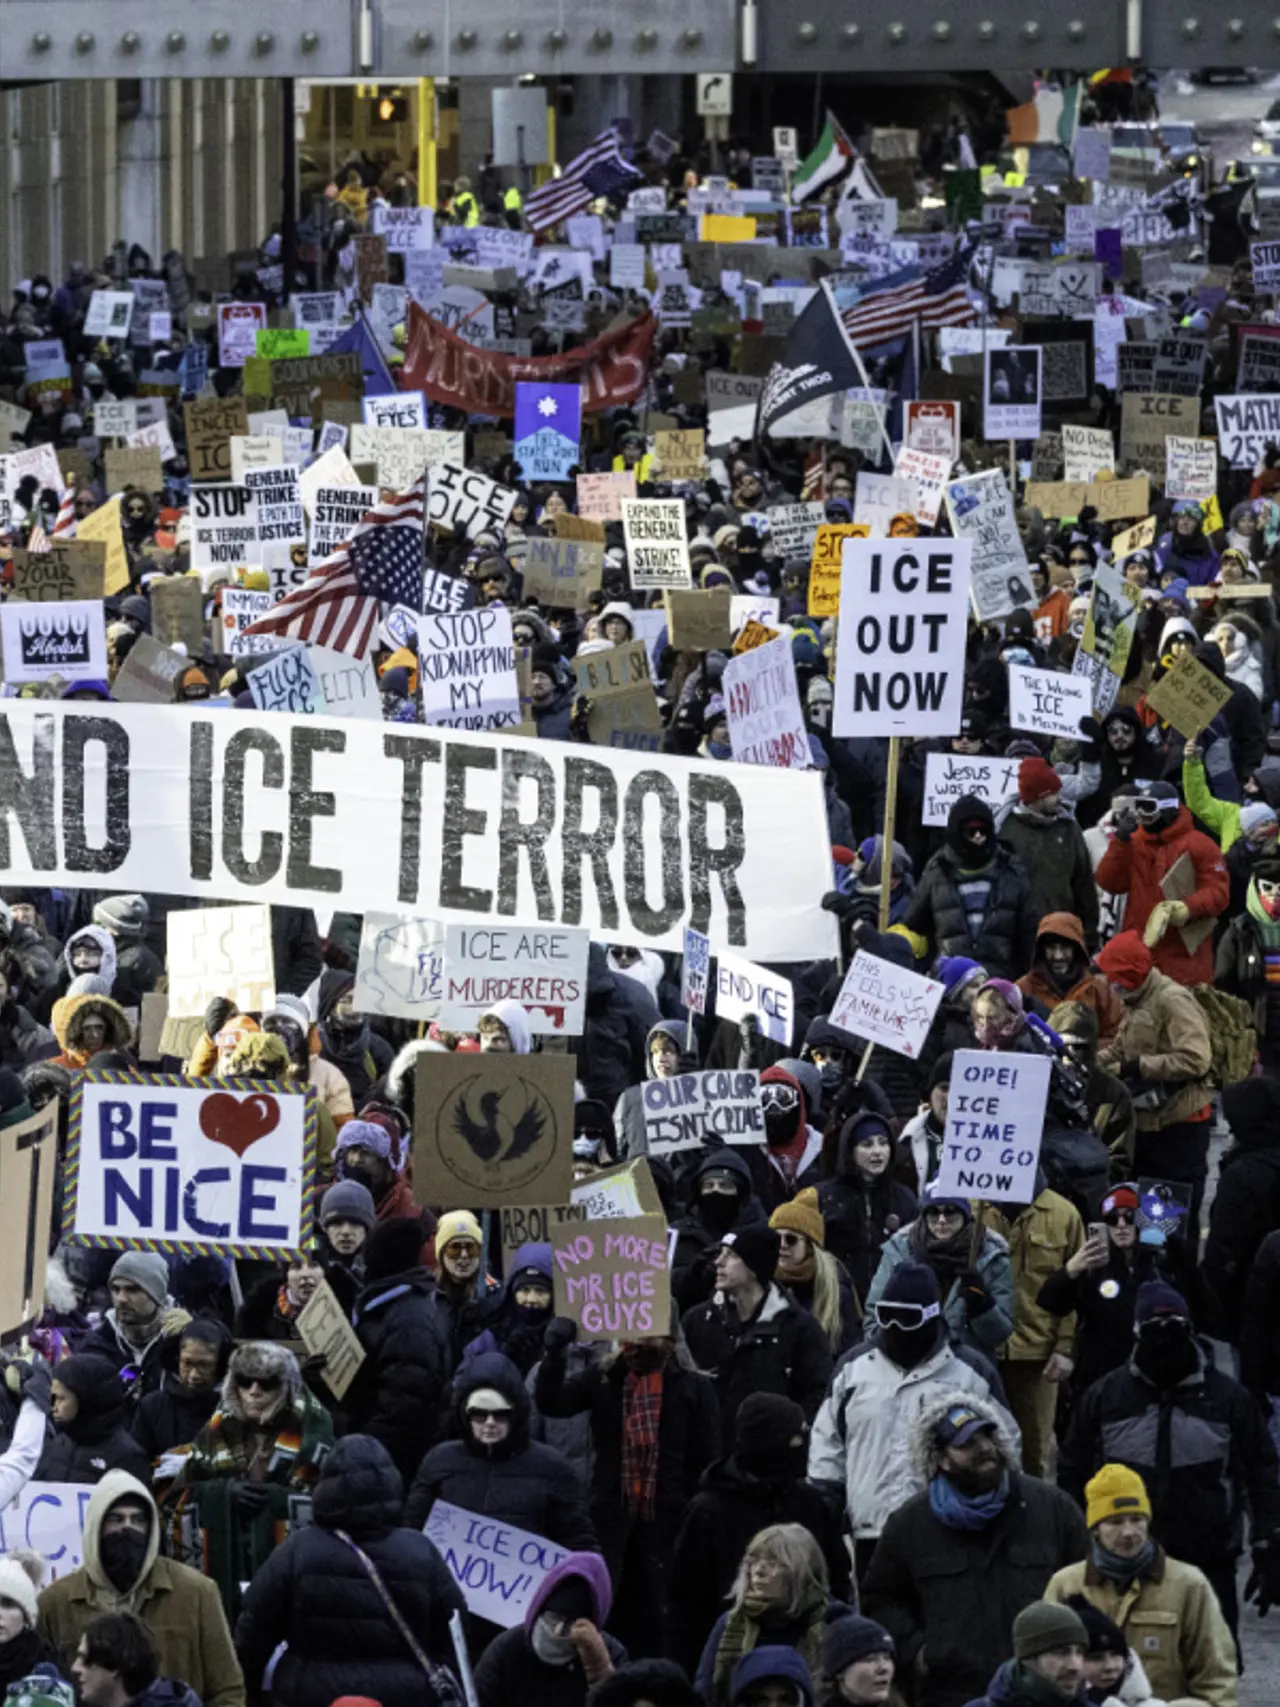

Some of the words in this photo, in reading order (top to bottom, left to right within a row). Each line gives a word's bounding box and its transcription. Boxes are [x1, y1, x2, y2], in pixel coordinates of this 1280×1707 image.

[386, 229, 417, 247] ICE
[1140, 396, 1184, 416] ICE
[244, 469, 298, 488] GENERAL
[533, 458, 563, 473] RUN
[194, 487, 252, 518] STOP
[315, 488, 375, 507] GENERAL
[438, 463, 514, 513] ICE
[627, 504, 660, 519] EXPAND
[660, 503, 681, 519] THE
[197, 526, 220, 543] ICE
[221, 525, 256, 543] TERROR
[630, 521, 683, 541] GENERAL
[210, 543, 248, 563] NOW!
[635, 548, 681, 567] STRIKE!
[18, 564, 75, 583] YOUR
[870, 554, 953, 594] ICE
[429, 611, 497, 650] STOP
[856, 614, 949, 654] OUT
[422, 650, 517, 682] KIDNAPPING
[251, 651, 312, 711] FUCK
[853, 672, 949, 713] NOW
[449, 683, 484, 710] MY
[1032, 694, 1064, 717] ICE
[943, 758, 992, 782] Jesus
[189, 720, 347, 896] ICE
[383, 733, 748, 949] TERROR
[461, 931, 508, 962] ICE
[515, 933, 570, 961] ARE
[447, 976, 581, 1004] MURDERERS
[719, 967, 754, 1002] END
[757, 982, 789, 1022] ICE
[645, 1074, 699, 1111] OUR
[964, 1066, 1018, 1090] OPE!
[711, 1104, 764, 1134] CRIME
[956, 1095, 999, 1116] ICE
[98, 1101, 179, 1161] BE
[951, 1120, 1017, 1143] TIME
[948, 1144, 981, 1163] TO
[999, 1147, 1034, 1168] GO
[957, 1169, 1013, 1192] NOW
[104, 1164, 290, 1241] NICE
[555, 1235, 594, 1272] NO
[604, 1233, 667, 1269] MORE
[566, 1275, 603, 1302] MR
[613, 1270, 657, 1298] ICE
[580, 1301, 655, 1335] GUYS
[464, 1518, 512, 1558] ICE
[444, 1547, 534, 1605] NOW!
